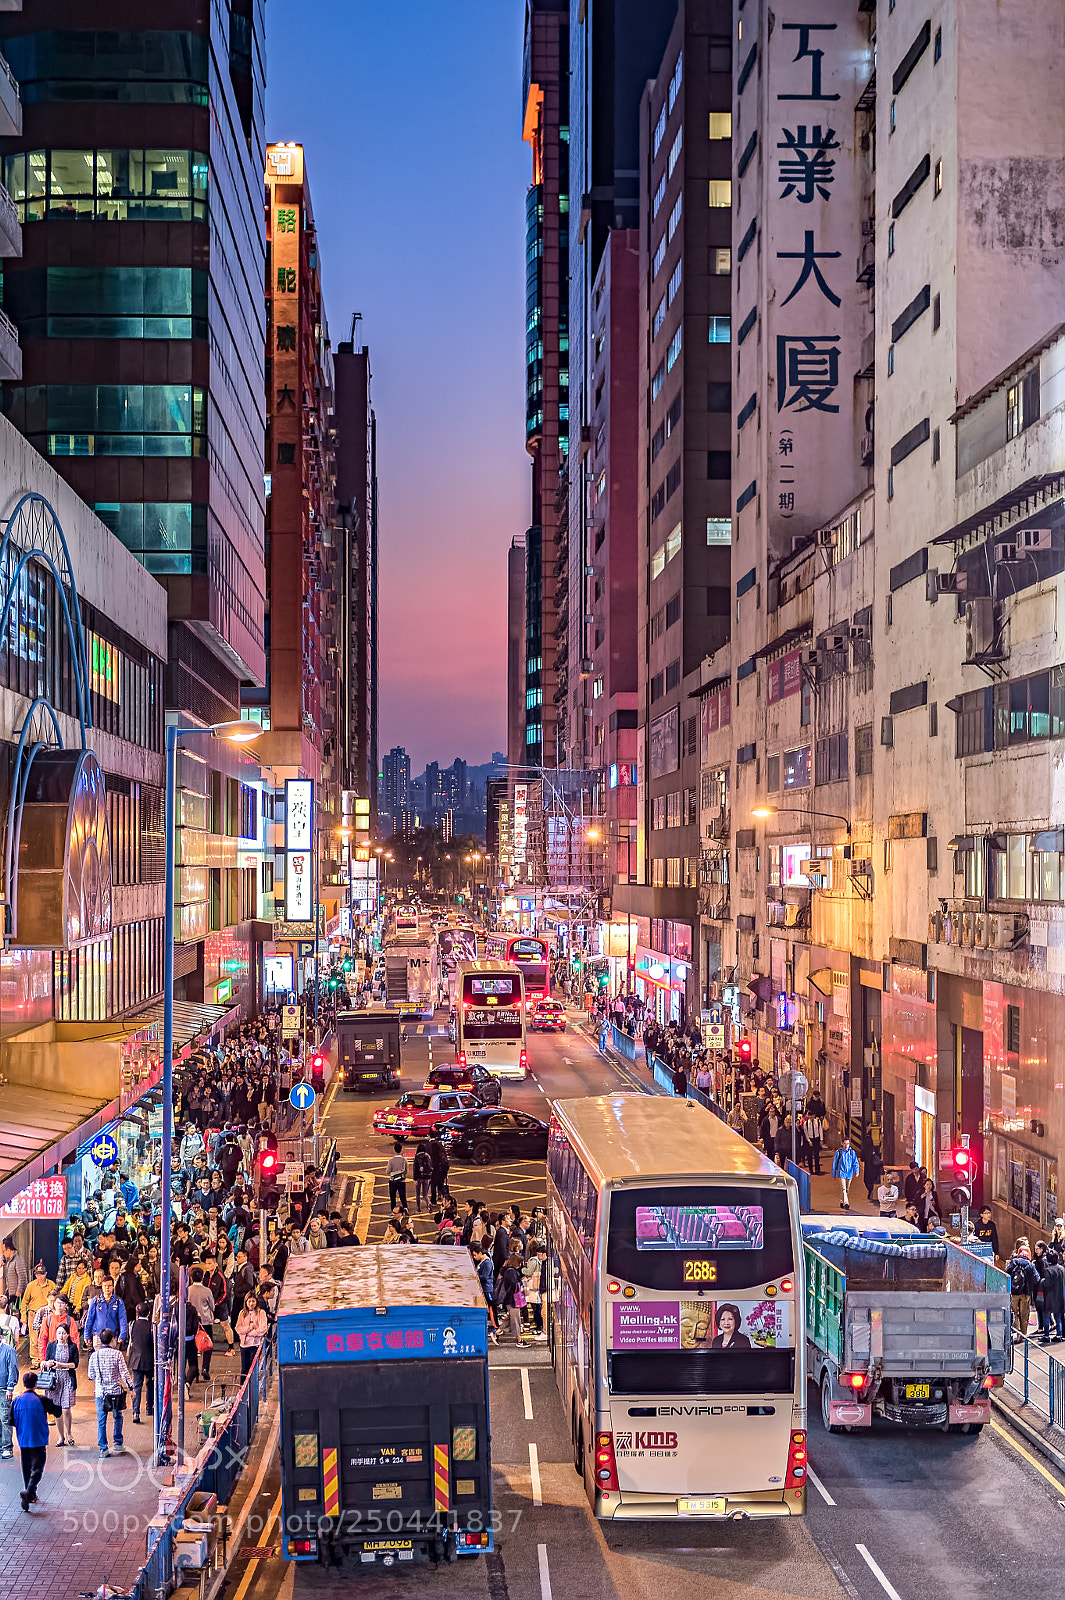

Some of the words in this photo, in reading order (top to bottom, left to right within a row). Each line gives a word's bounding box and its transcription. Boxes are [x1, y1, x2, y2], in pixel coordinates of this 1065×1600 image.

[777, 23, 840, 413] 工業大廈
[301, 943, 313, 956] P
[43, 1198, 61, 1214] 1678
[657, 1326, 675, 1334] New
[326, 1330, 424, 1353] 貨車支援組
[635, 1432, 678, 1449] KMB
[380, 1448, 396, 1456] VAN
